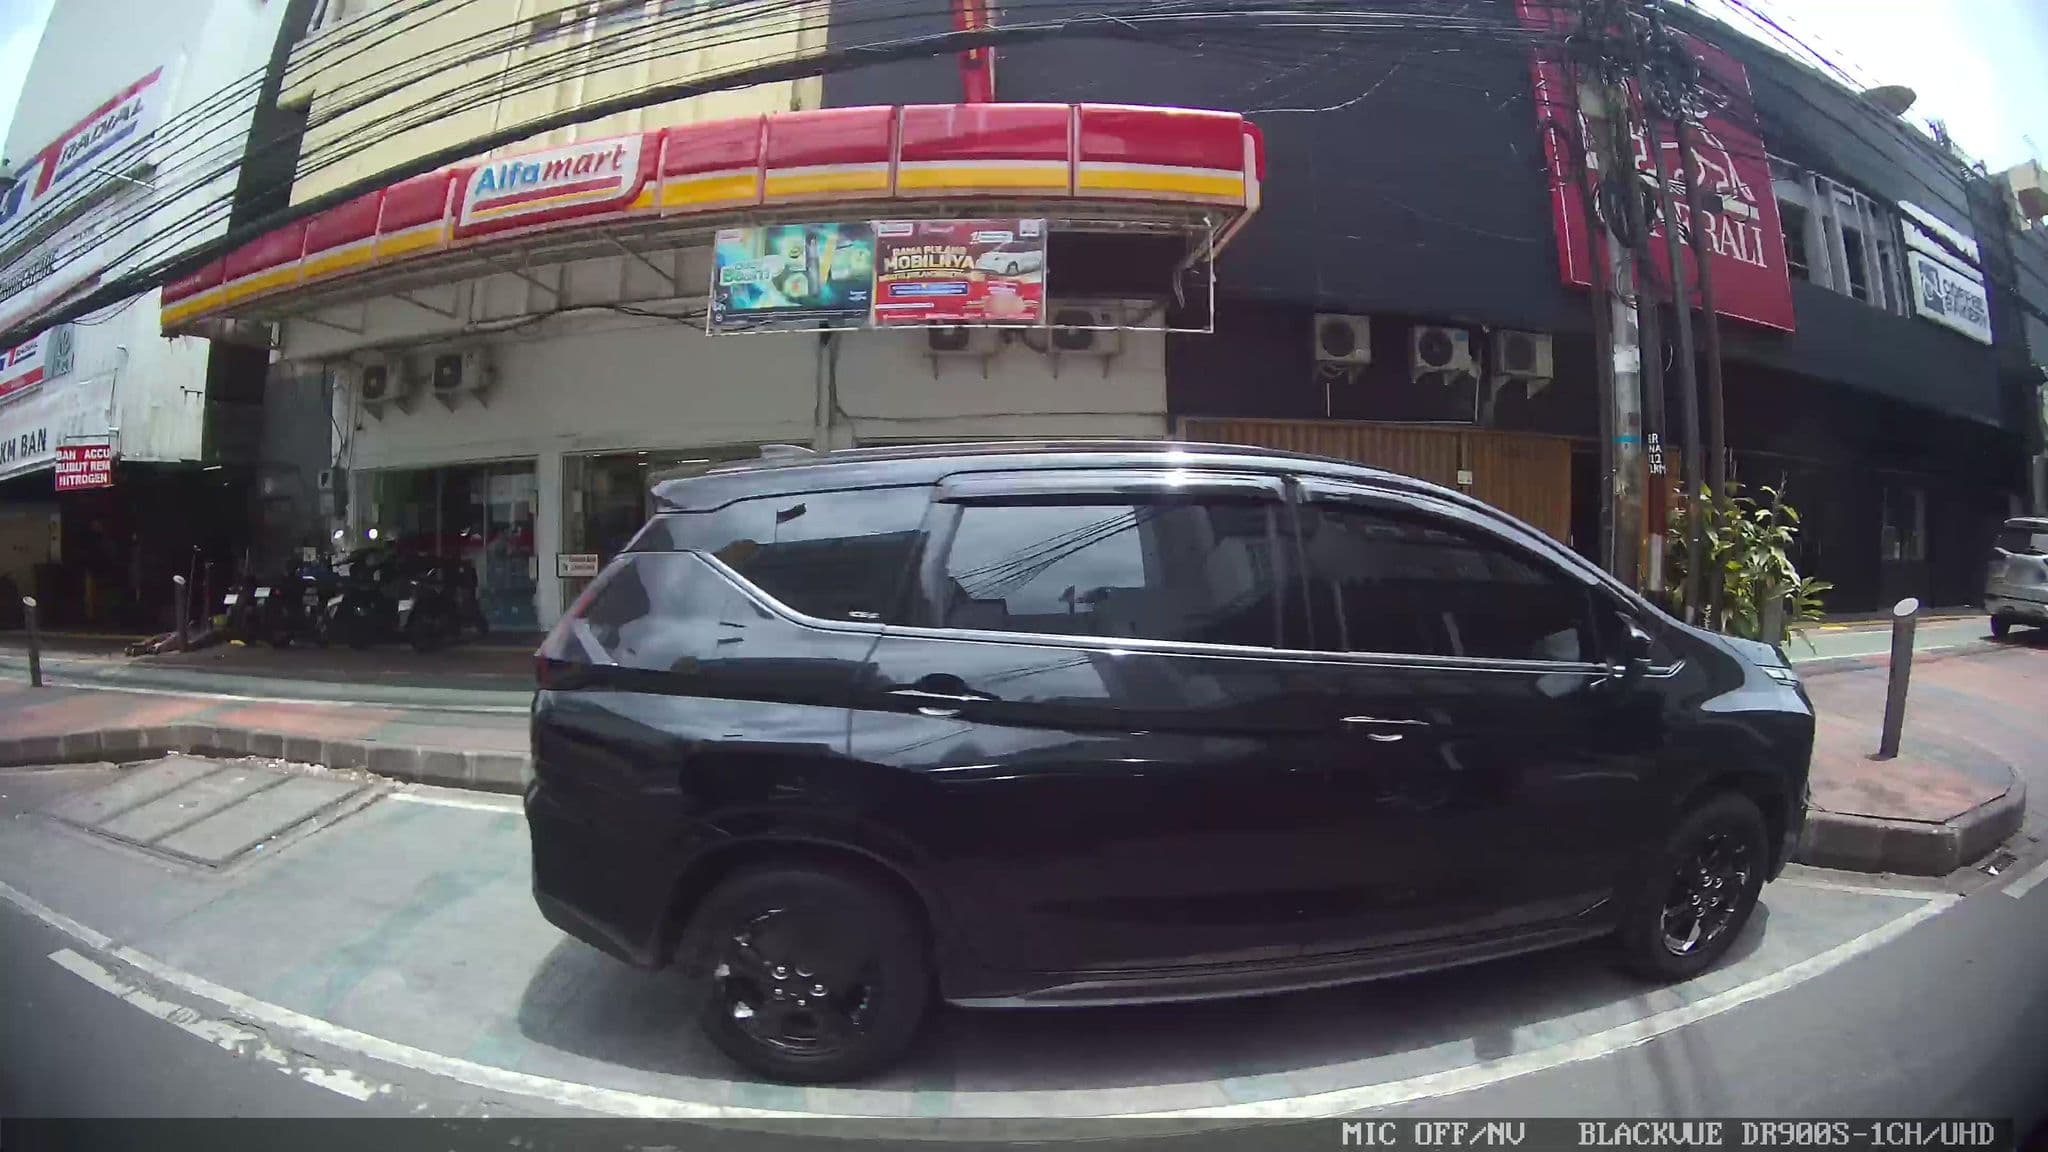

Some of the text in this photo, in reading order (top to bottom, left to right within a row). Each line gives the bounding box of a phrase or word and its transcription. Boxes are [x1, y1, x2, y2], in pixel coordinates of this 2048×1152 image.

[474, 143, 627, 196] Alfamart
[883, 254, 975, 272] MOBILNYA
[21, 428, 47, 457] BAN
[84, 448, 110, 460] ACCU
[59, 473, 108, 486] NITROGEN
